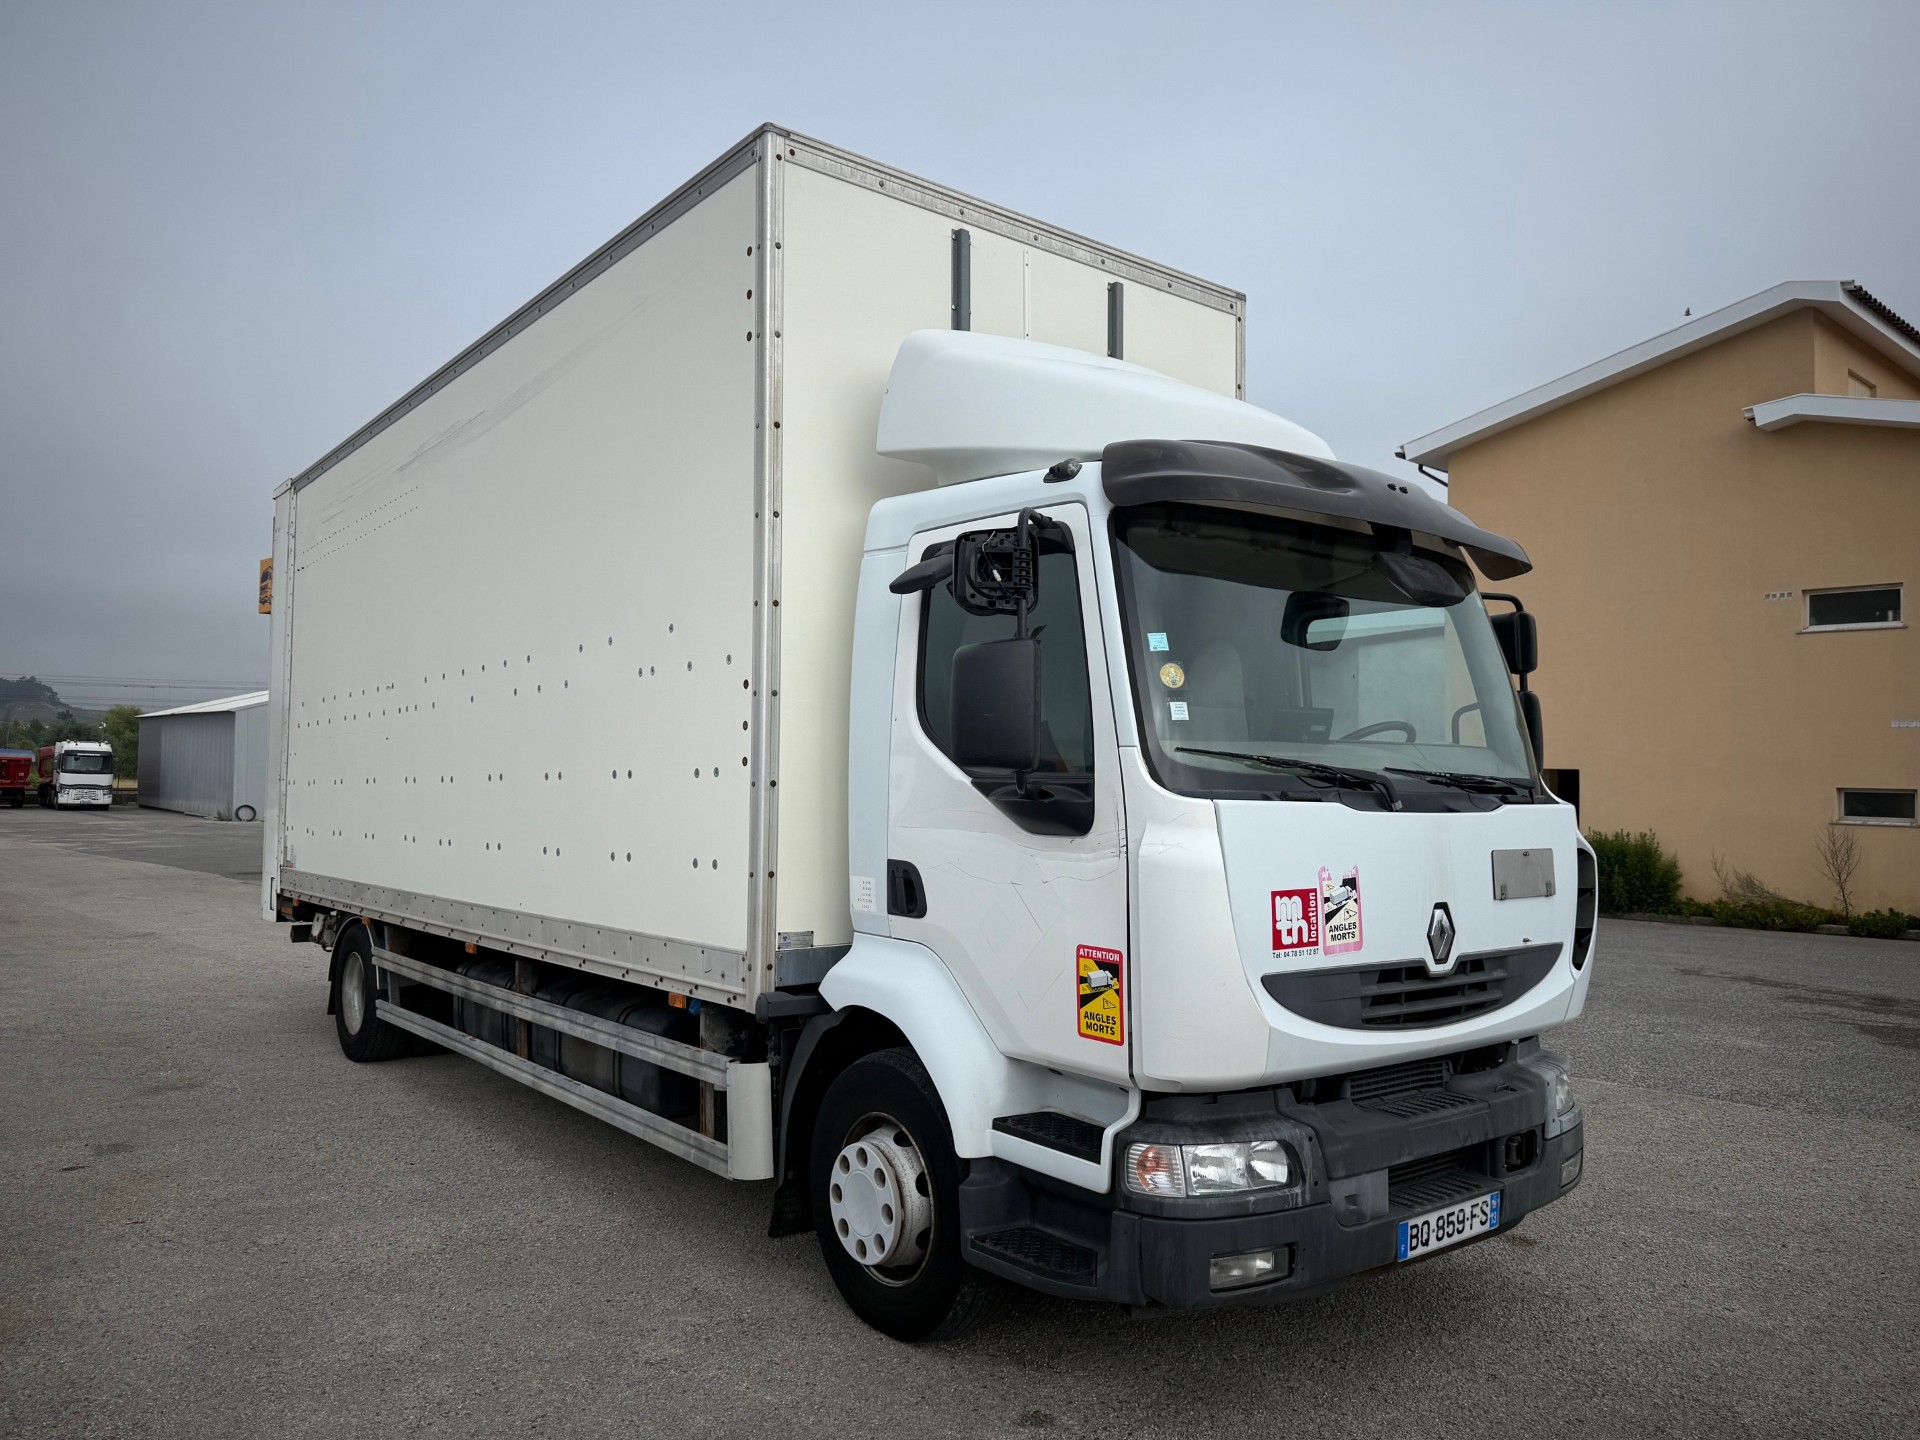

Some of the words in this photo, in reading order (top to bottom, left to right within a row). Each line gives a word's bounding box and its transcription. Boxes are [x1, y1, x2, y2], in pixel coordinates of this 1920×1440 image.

[1308, 892, 1316, 941] location
[1329, 922, 1357, 933] ANGLES
[1331, 931, 1356, 942] MORTS
[1079, 948, 1120, 961] ATTENTION
[1298, 949, 1305, 957] 51
[1306, 948, 1312, 956] 12
[1084, 1010, 1117, 1026] ANGLES
[1085, 1021, 1116, 1036] MORTS
[1409, 1200, 1489, 1252] BQ-859-FS
